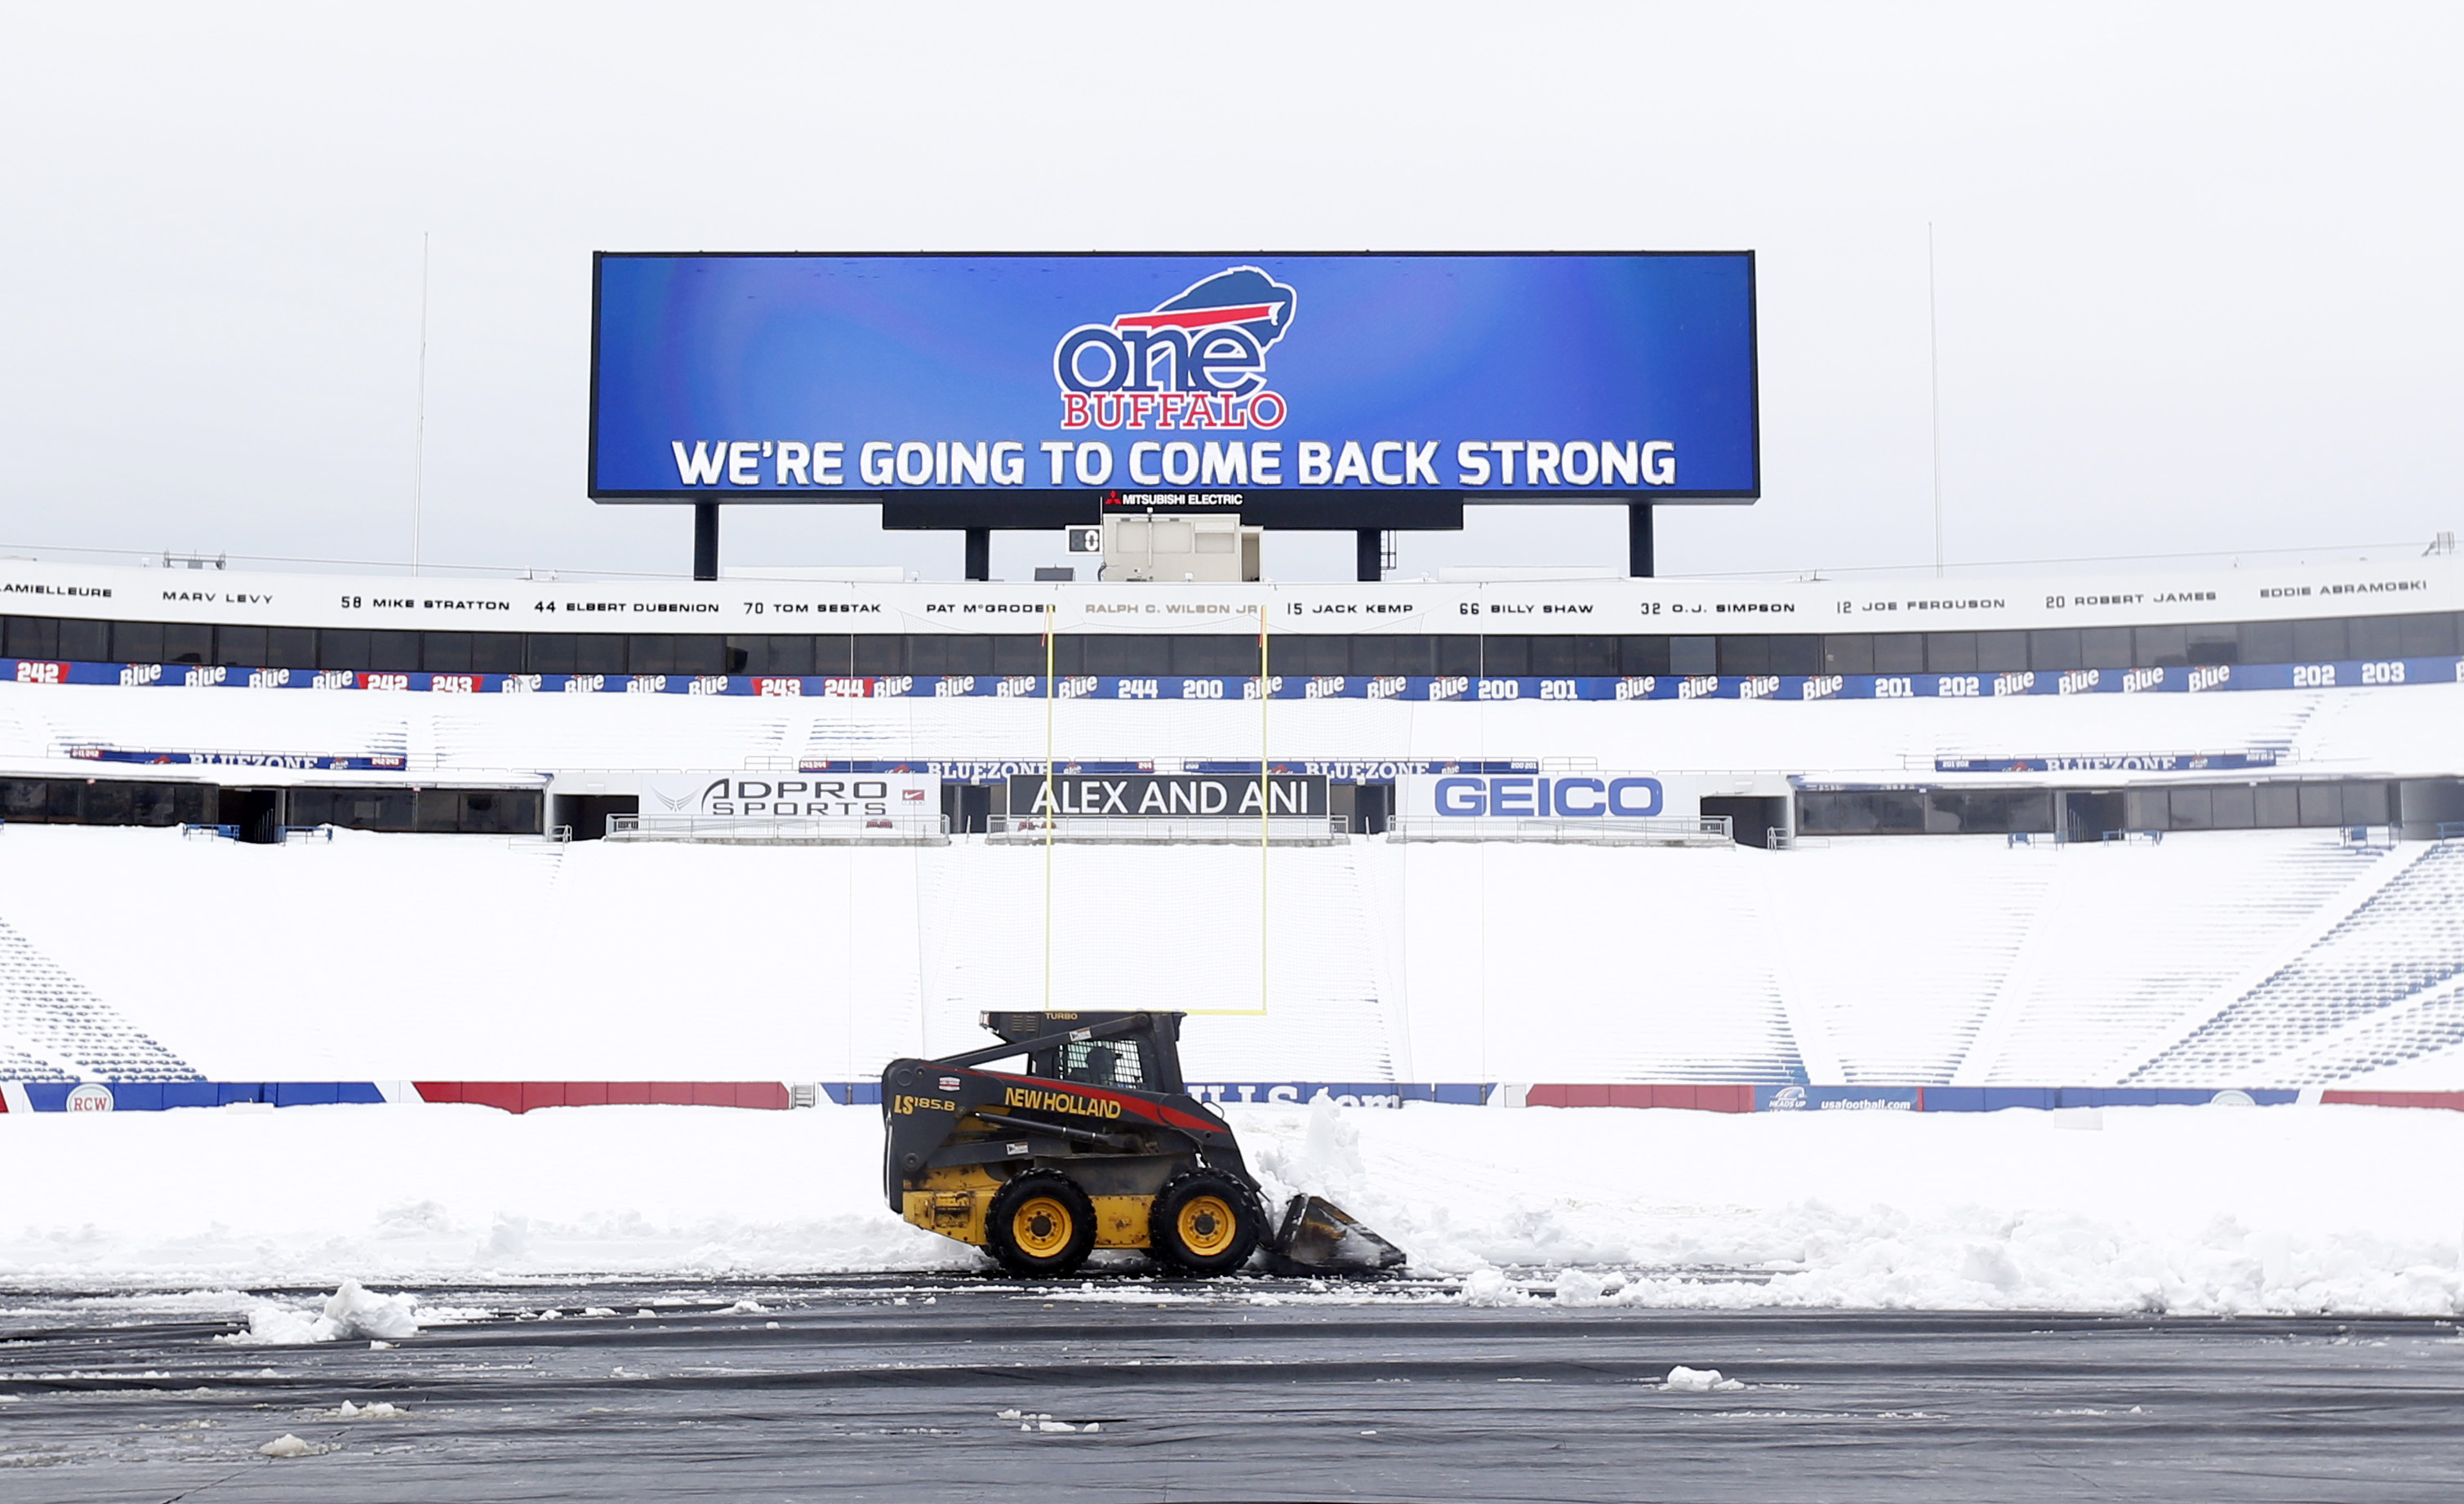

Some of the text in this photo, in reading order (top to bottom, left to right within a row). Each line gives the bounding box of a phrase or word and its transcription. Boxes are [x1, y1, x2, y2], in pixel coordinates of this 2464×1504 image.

[1055, 325, 1266, 399] one
[1061, 392, 1287, 429] BUFFALO
[671, 439, 1676, 486] WE'RE GOING TO COME BACK STRONG
[1123, 494, 1243, 505] MITSUBISHI ELECTRIC
[0, 583, 113, 598] AMIELLEURE
[162, 590, 273, 604] MARV LEVY
[2260, 579, 2427, 598] EDDIE ABRAMOSKI
[341, 596, 510, 611] 58 MIKE STRATTON
[534, 600, 719, 613] 44 ELBERT DUBENION
[743, 602, 882, 615] 70 TOM SESTAK
[926, 603, 956, 613] PAT
[1085, 603, 1139, 614] RALPH
[1145, 603, 1161, 614] C.
[1165, 603, 1230, 614] WILSON
[1287, 603, 1413, 615] 15 JACK KEMP
[1459, 603, 1594, 615] 66 BILLY SHAW
[1640, 603, 1661, 615] 32
[1715, 603, 1795, 613] SIMPSON
[1836, 598, 2006, 614] 12 JOE FERGUSON
[2046, 591, 2217, 609] 20 ROBERT JAMES
[17, 661, 60, 683] 242
[120, 663, 162, 687] Blue
[185, 665, 227, 687] Blue
[248, 668, 290, 689] Blue
[312, 670, 354, 690] Blue
[367, 674, 409, 691] 242
[2058, 668, 2100, 695] Blue
[2123, 665, 2164, 694] Blue
[2187, 664, 2231, 693] Blue
[2293, 665, 2336, 687] 202
[2361, 661, 2406, 684] 203
[432, 675, 474, 693] 243
[501, 674, 543, 693] Ble
[563, 674, 605, 693] Blue
[626, 674, 667, 694] Blue
[688, 674, 729, 696] Blue
[760, 678, 802, 697] 243
[825, 678, 865, 698] 244
[874, 675, 914, 698] Blue
[935, 675, 976, 698] Blue
[996, 675, 1037, 698] Blue
[1058, 675, 1099, 699] Blue
[1117, 679, 1159, 699] 244
[1182, 679, 1224, 699] 200
[1243, 675, 1283, 701] Blue
[1305, 675, 1345, 700] Blue
[1366, 675, 1408, 700] Blue
[1428, 675, 1470, 701] Blue
[1477, 679, 1519, 700] 200
[1540, 679, 1579, 700] 201
[1615, 675, 1657, 701] Blue
[1678, 675, 1719, 701] Blue
[1739, 675, 1781, 701] Blue
[1802, 674, 1844, 701] Blue
[1874, 677, 1915, 698] 201
[1937, 676, 1980, 697] 202
[1993, 670, 2035, 696] Blue
[1305, 761, 1430, 779] BLUEZONE
[701, 778, 887, 804] ADPRO
[1030, 781, 1308, 813] ALEX AND ANI
[1434, 776, 1663, 817] GEICO
[712, 802, 887, 816] SPORTS
[73, 1097, 108, 1110] RCW
[1004, 1087, 1122, 1119] NEW HOLLAND
[1821, 1098, 1911, 1110] usafootball.com
